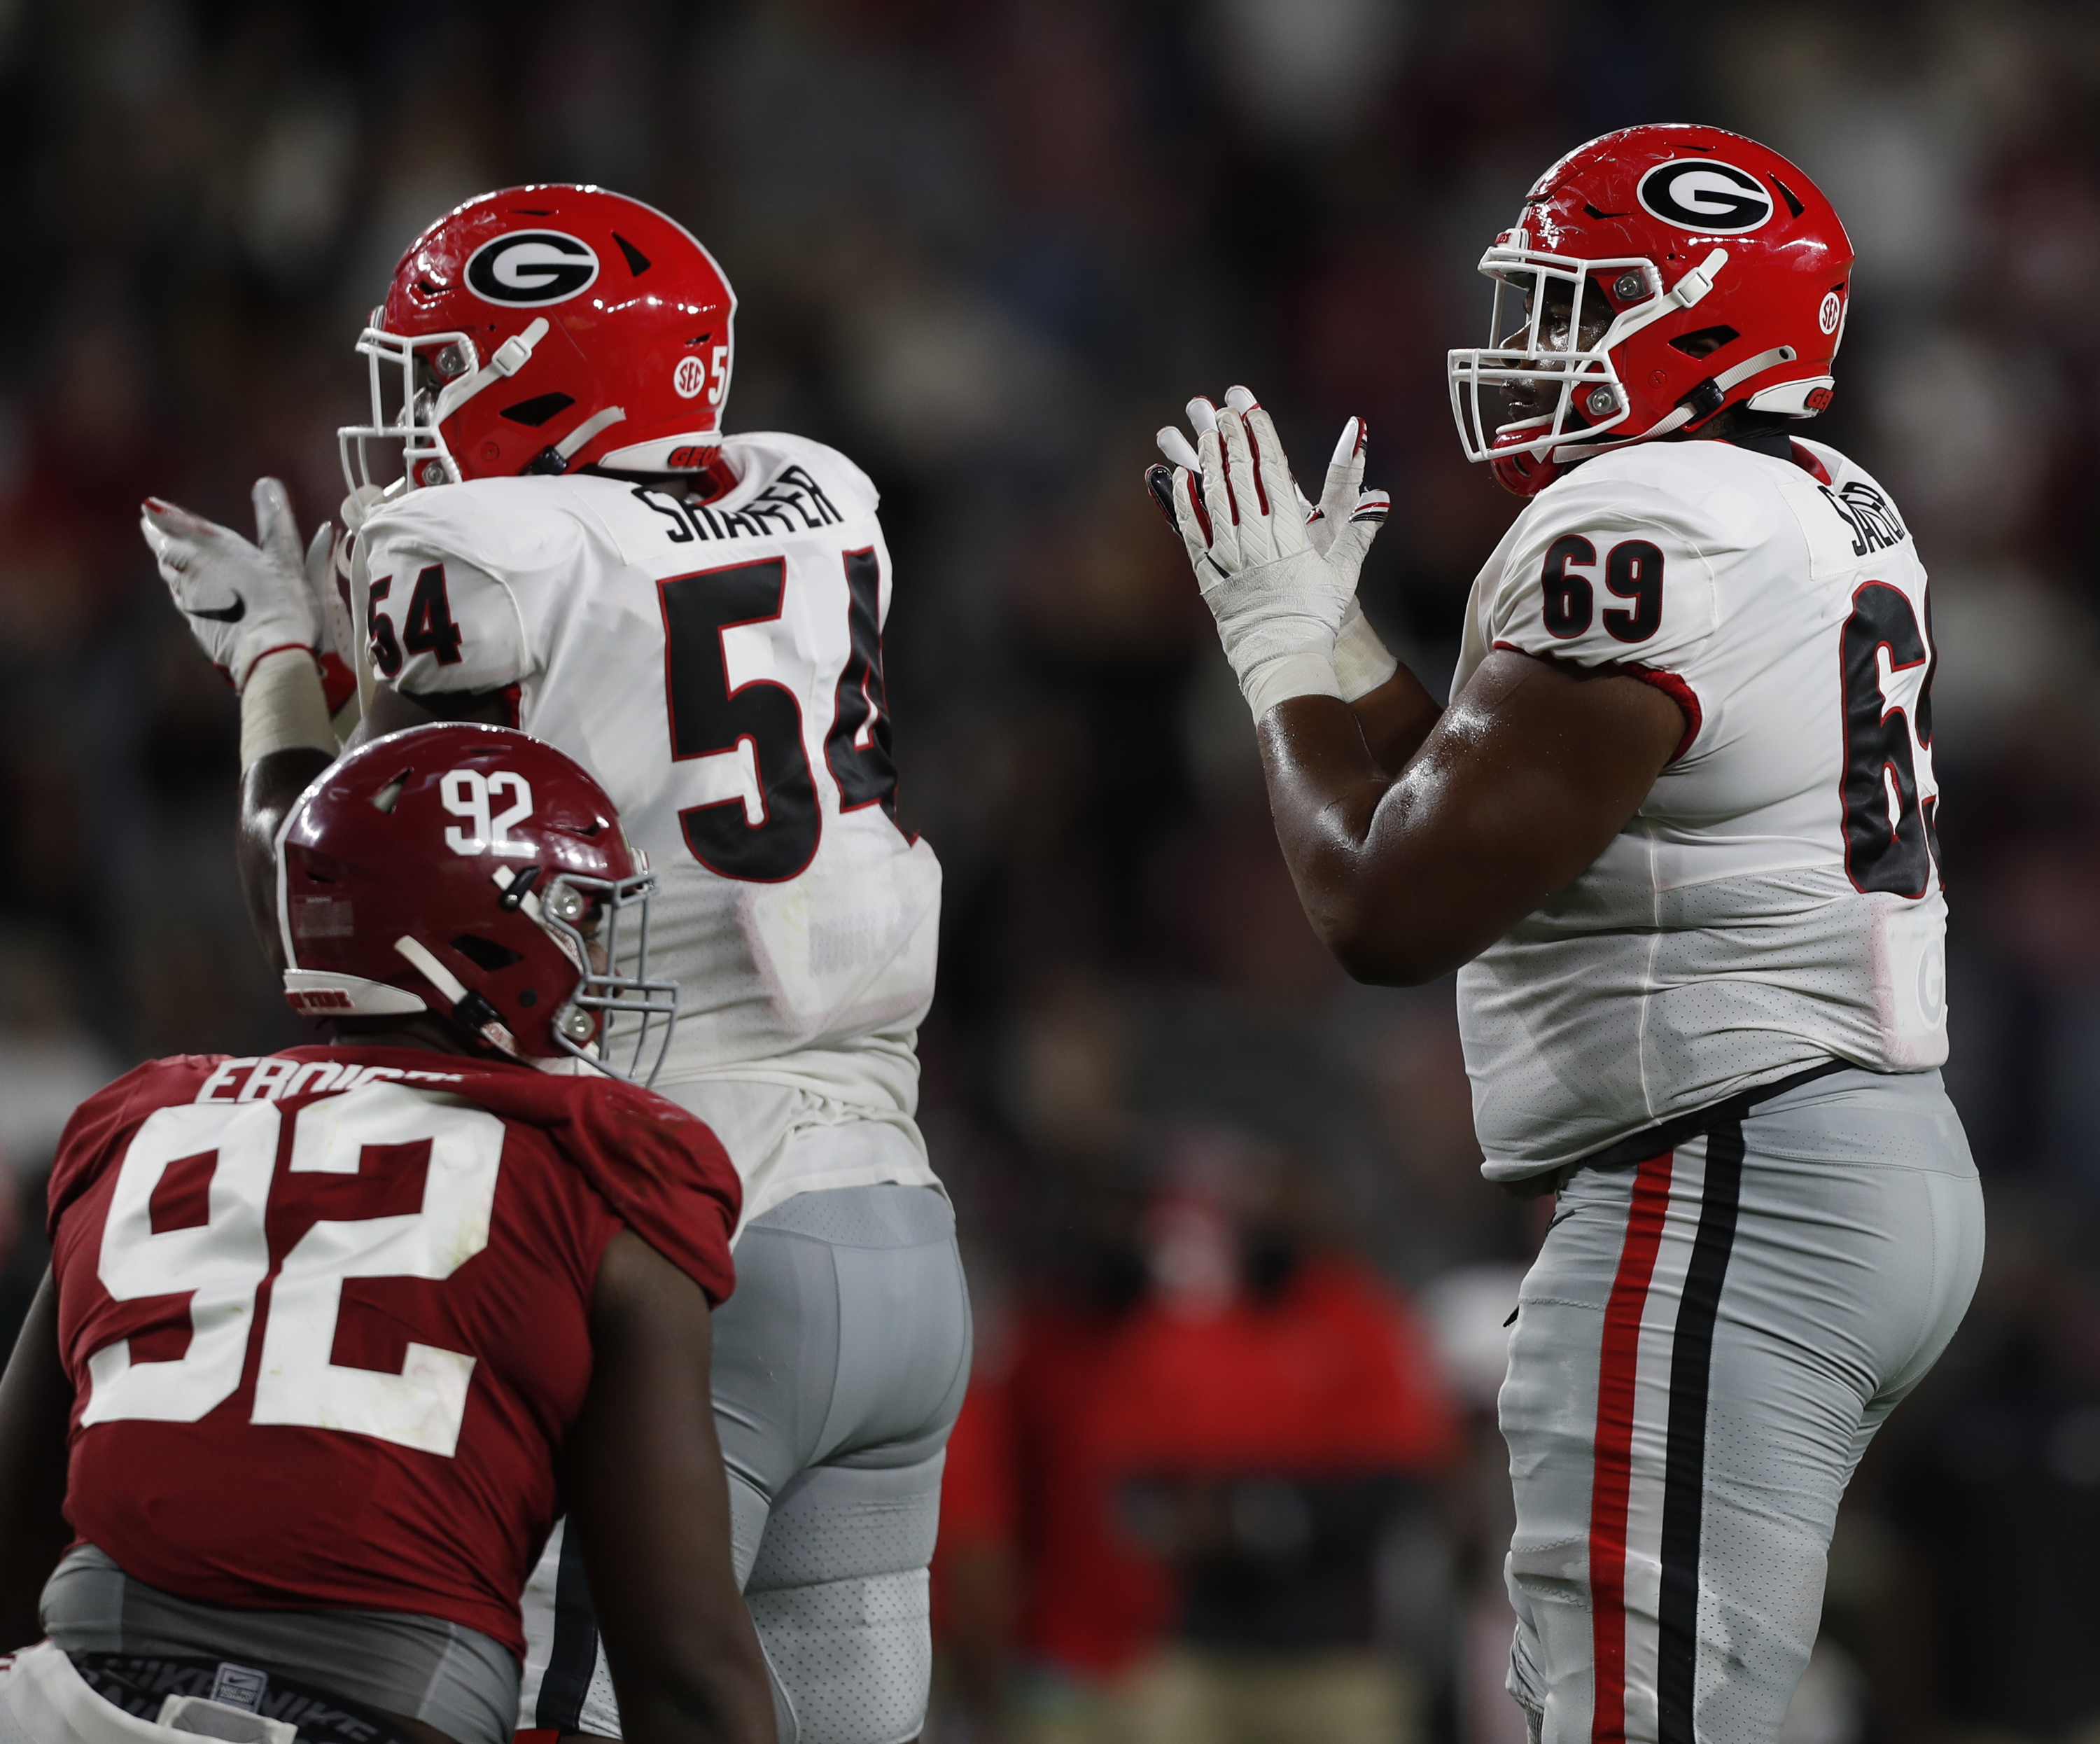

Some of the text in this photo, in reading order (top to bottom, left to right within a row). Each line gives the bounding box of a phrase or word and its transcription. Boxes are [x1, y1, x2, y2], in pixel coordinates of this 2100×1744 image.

[1642, 161, 1770, 230] G
[468, 233, 595, 302] G
[1821, 297, 1838, 330] SEC
[678, 360, 702, 393] SEC
[368, 563, 462, 677] 54
[1542, 534, 1665, 643] 69
[657, 545, 920, 884] 54
[1839, 580, 1945, 899] 6
[440, 769, 536, 859] 92
[79, 1081, 506, 1458] 92
